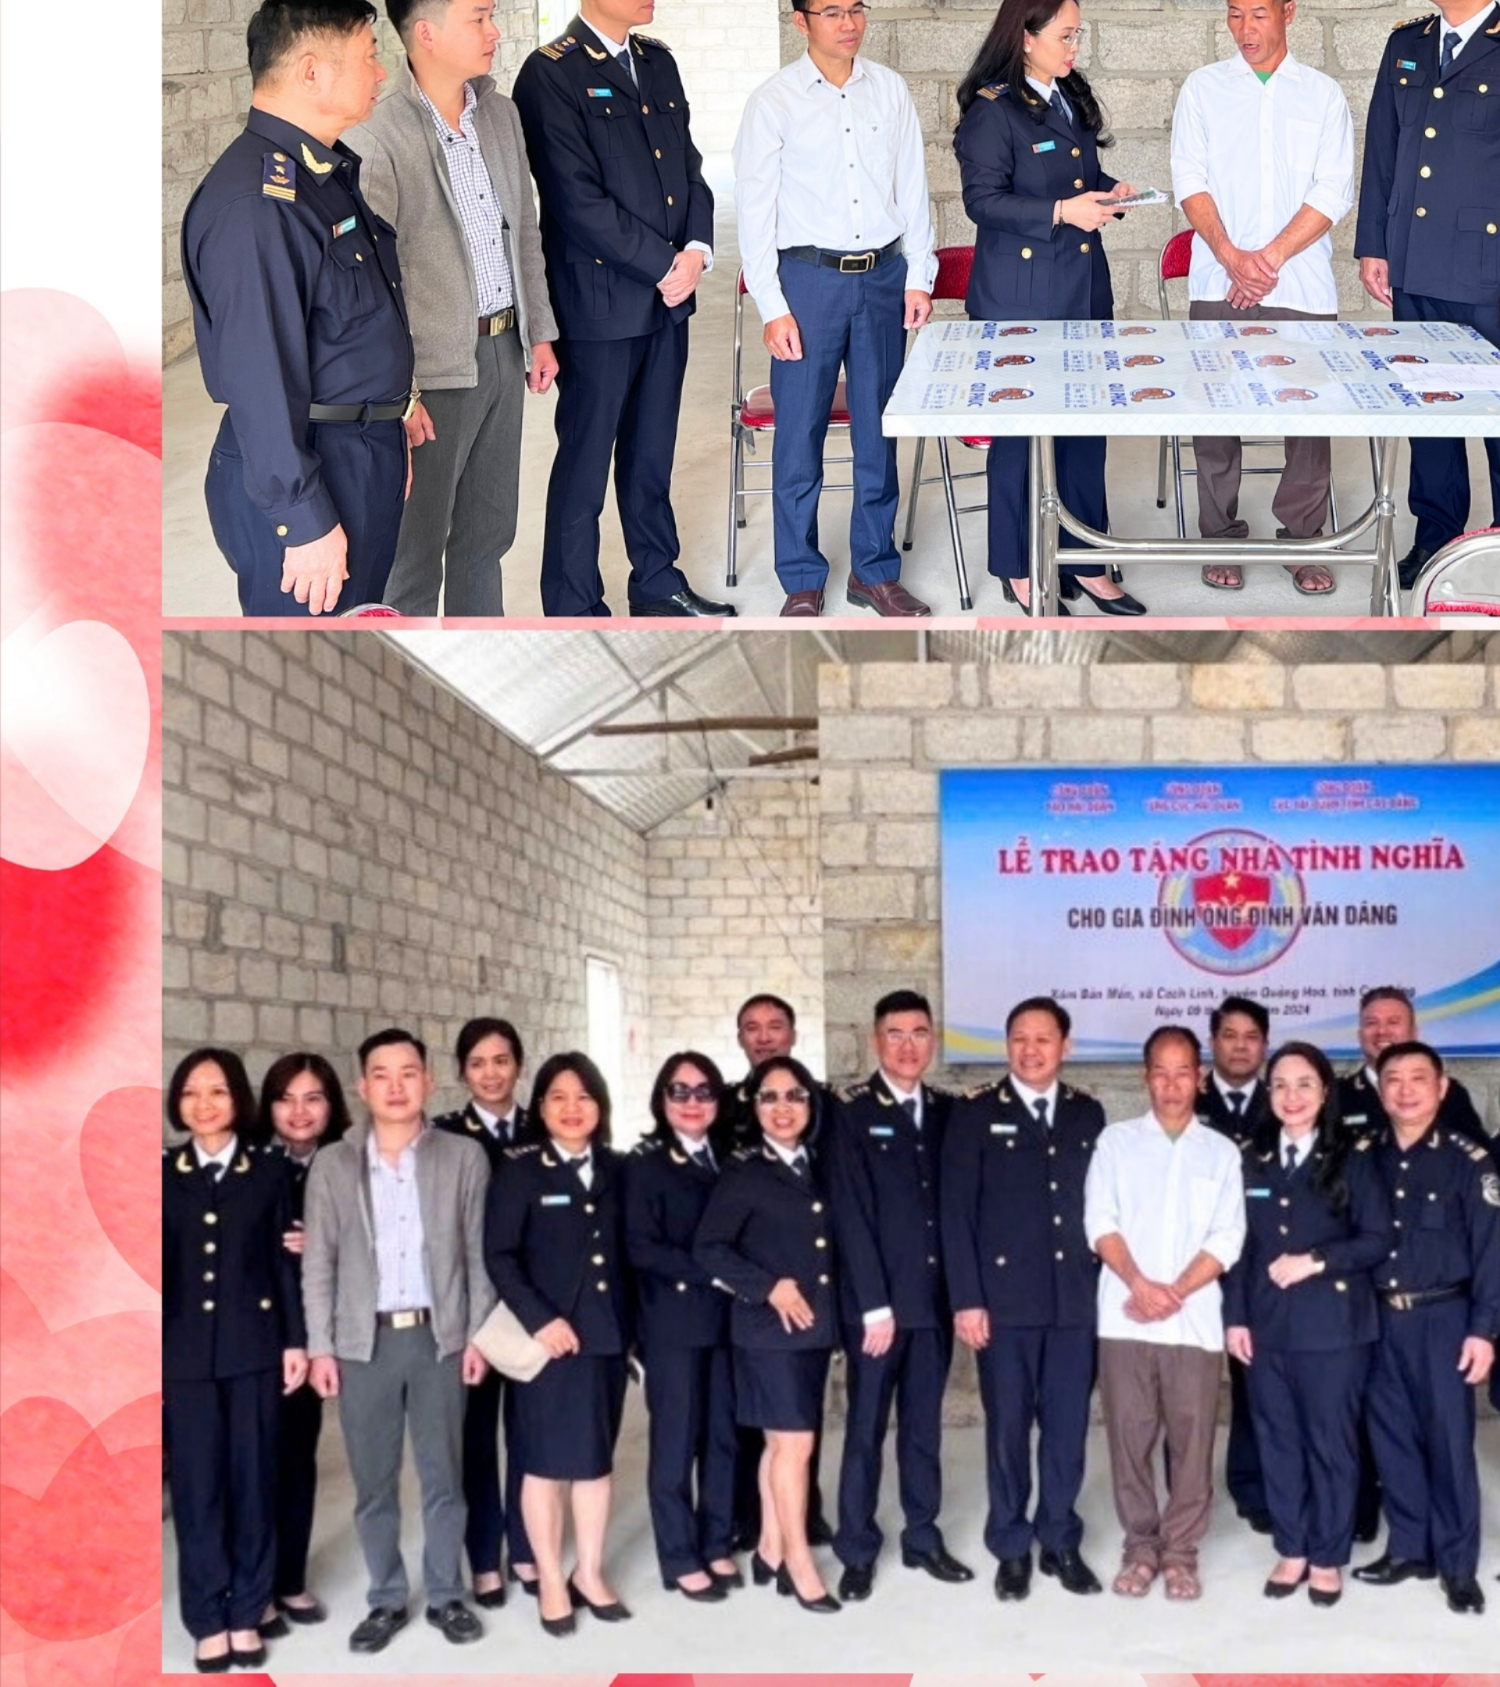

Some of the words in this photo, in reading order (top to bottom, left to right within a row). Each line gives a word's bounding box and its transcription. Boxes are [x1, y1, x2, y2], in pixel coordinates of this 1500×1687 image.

[1041, 848, 1120, 874] TRAO
[1129, 840, 1209, 878] TẶNG
[1220, 840, 1281, 872] NHÀ
[1292, 838, 1361, 870] TÌNH
[1371, 836, 1464, 870] NGHĨA
[1068, 908, 1105, 928] CHO
[1112, 908, 1144, 928] GIA
